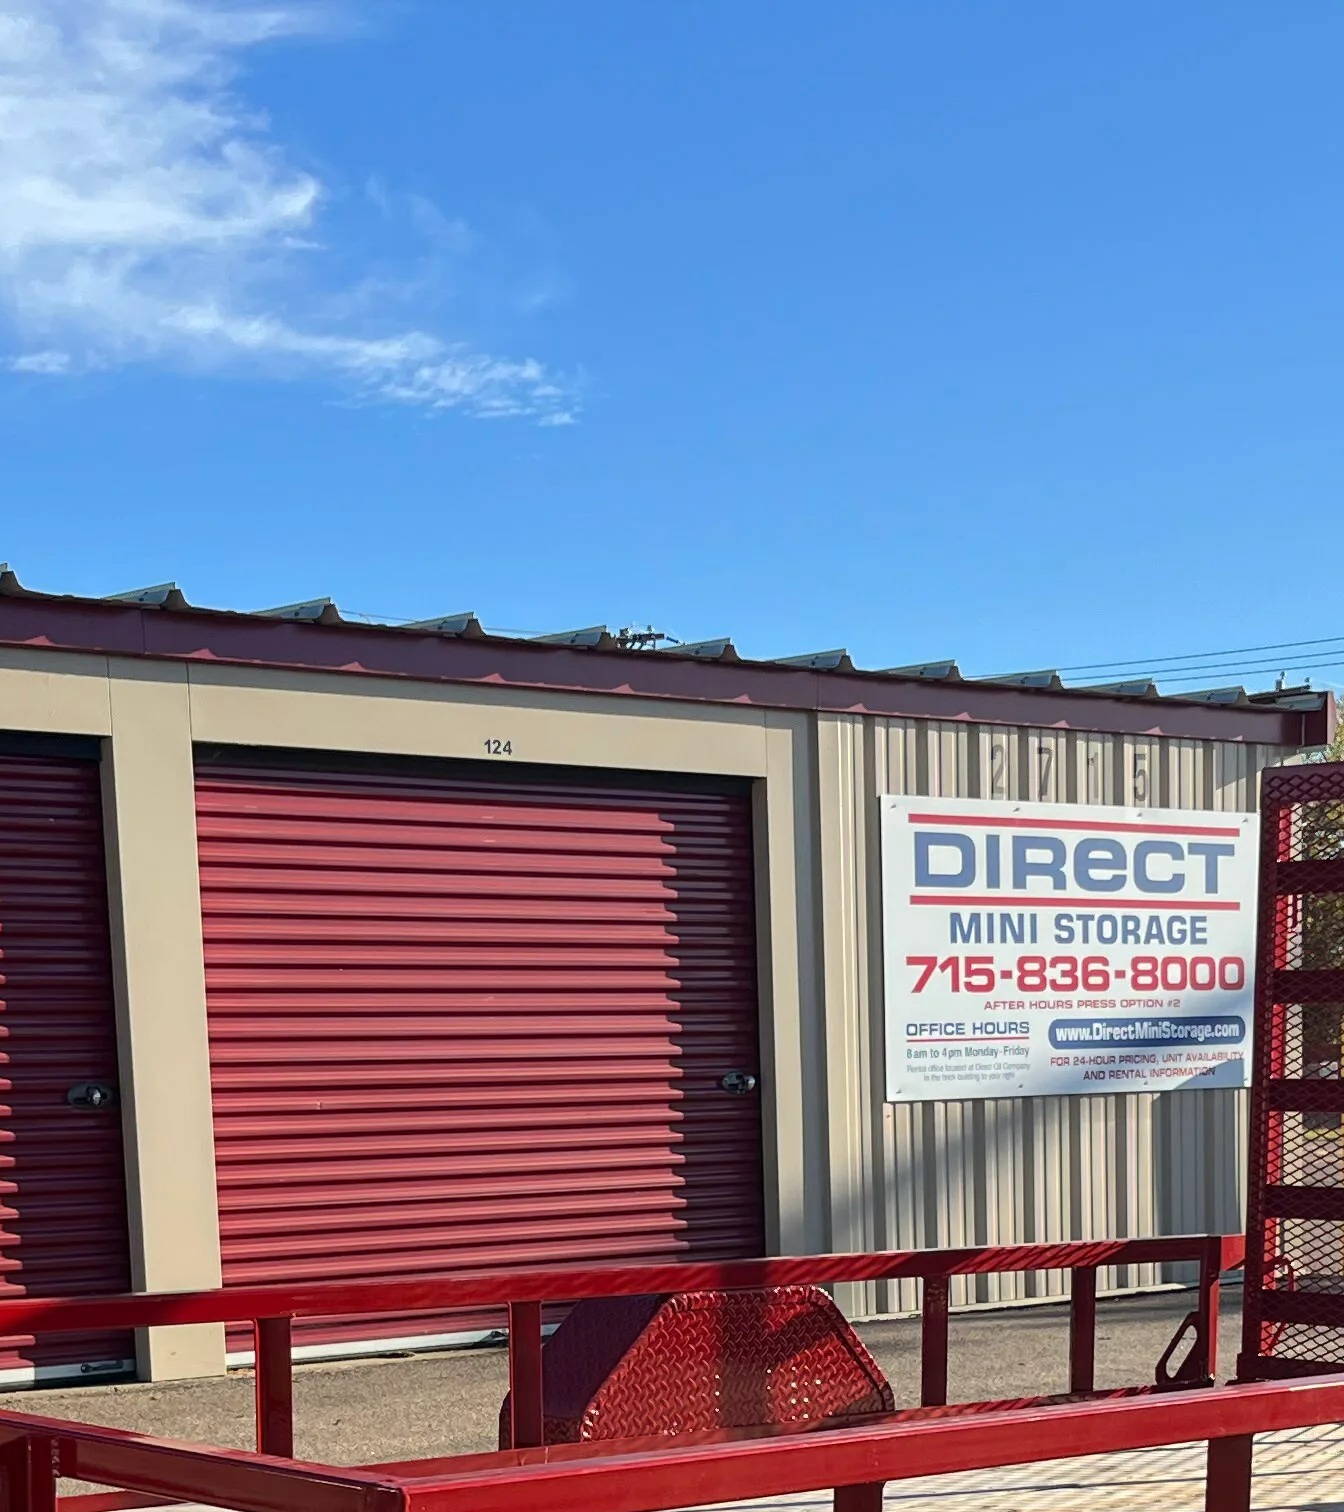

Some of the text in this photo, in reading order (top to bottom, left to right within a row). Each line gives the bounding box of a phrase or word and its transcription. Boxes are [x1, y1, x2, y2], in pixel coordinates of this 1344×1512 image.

[484, 739, 512, 756] 124
[991, 744, 1148, 802] 2715
[949, 911, 1208, 946] MINI STORAGE
[906, 956, 1246, 994] 715-836-8000
[984, 999, 1181, 1010] AFTER HOURS PRESS OPTION #2
[906, 1021, 1030, 1036] OFFICE HOURS
[1055, 1021, 1240, 1042] www.DirectMiniStorage.com
[930, 1048, 940, 1058] to
[1050, 1056, 1070, 1066] FOR
[1073, 1055, 1116, 1066] 24-HOUR
[1162, 1052, 1183, 1063] UNIT
[1185, 1051, 1244, 1063] AVAILABILITY
[1083, 1066, 1216, 1081] AND RENTAL INFORMATION
